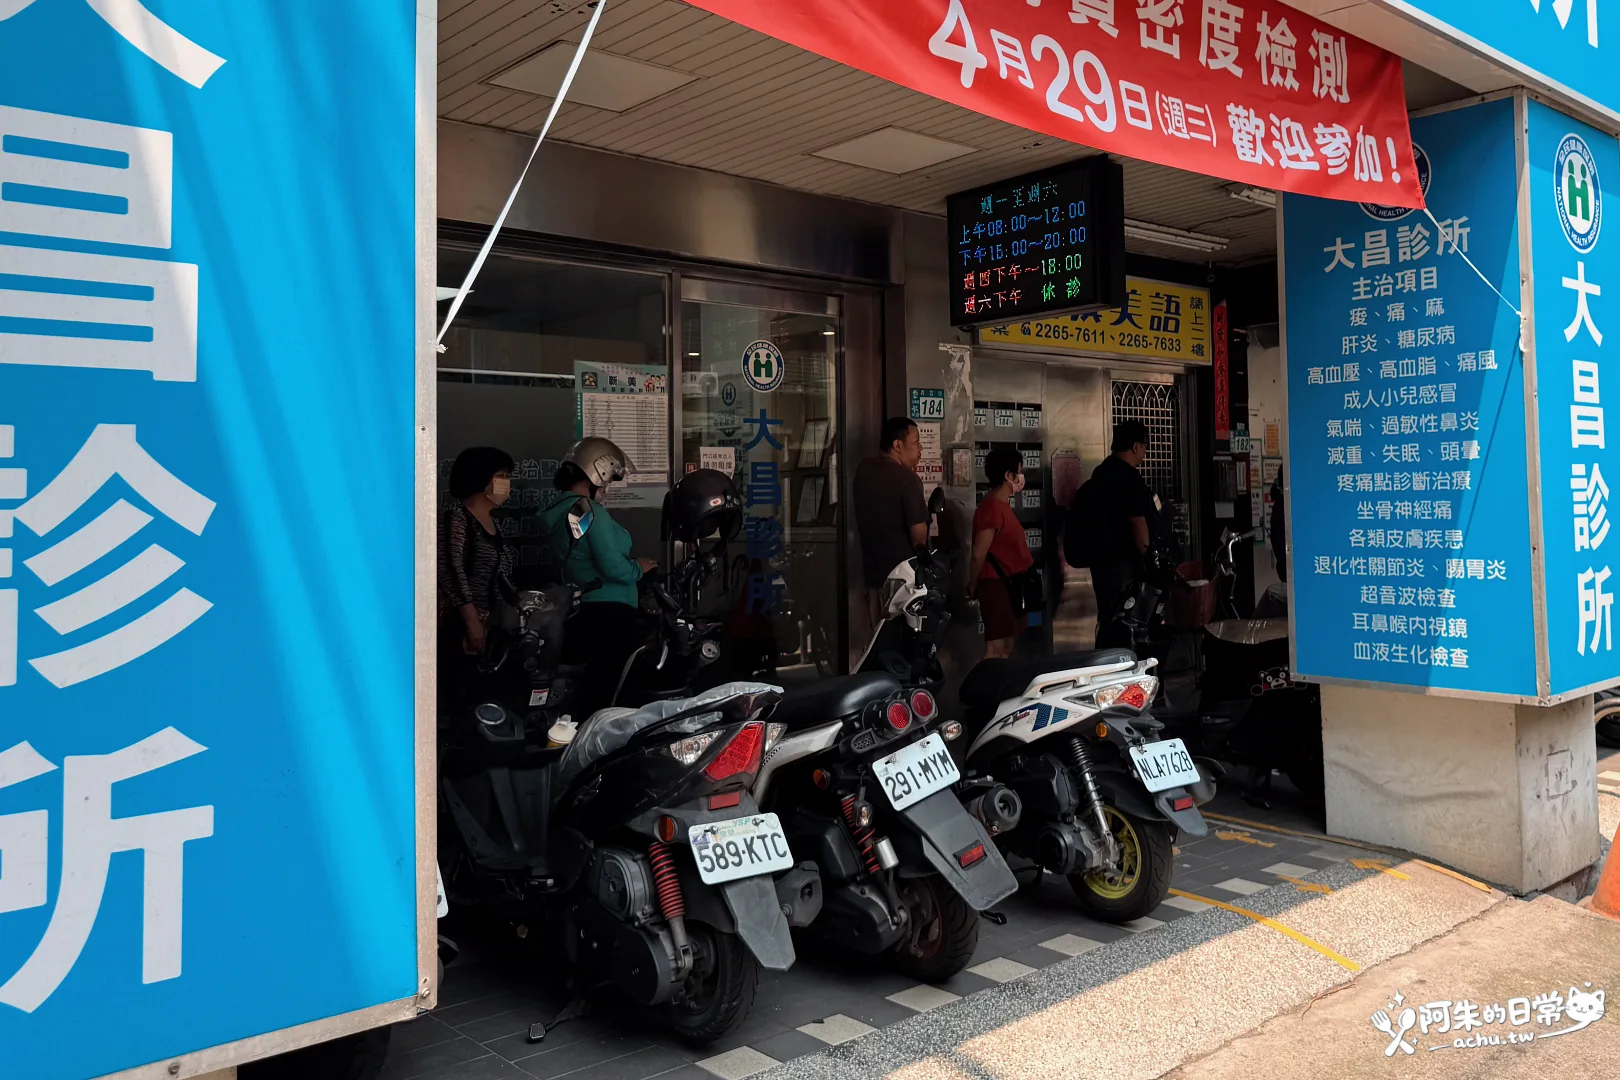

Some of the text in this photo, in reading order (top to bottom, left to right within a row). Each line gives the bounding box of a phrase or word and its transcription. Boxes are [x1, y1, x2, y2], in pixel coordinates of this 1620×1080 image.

[1026, 0, 1350, 103] 密度檢測
[1227, 102, 1401, 184] 歡迎參加!
[1379, 208, 1405, 217] HEALTH
[1323, 216, 1471, 273] 大昌診所
[1571, 231, 1588, 246] HEALTH
[1352, 267, 1438, 300] 主治項目
[964, 288, 1023, 314] 週六下午
[1189, 295, 1204, 357] 請上二樓
[1342, 325, 1456, 355] 肝炎、糖尿病
[1307, 350, 1498, 385] 高血壓、高血脂、痛風
[922, 399, 942, 415] 184
[1343, 383, 1457, 410] 成人小兒感冒
[1326, 411, 1479, 438] 氣喘、過敏性鼻炎
[1236, 438, 1249, 451] 182
[1327, 440, 1480, 465] 減重、失眠、頭暈
[1562, 261, 1614, 656] 大昌診所
[1337, 470, 1472, 493] 疼痛點診斷治療
[743, 408, 785, 614] 大昌診所
[1357, 501, 1452, 520] 坐骨神經痛
[1349, 529, 1464, 550] 各類皮膚疾患
[1314, 556, 1507, 580] 退化性關節炎、腸胃炎
[1360, 585, 1456, 608] 超音波檢查
[1352, 612, 1468, 638] 耳鼻喉內視鏡
[1353, 641, 1469, 668] 血液生化檢查
[884, 749, 956, 802] 291-MYM
[1137, 749, 1193, 782] NLA-7628
[697, 832, 787, 873] 589-KTC
